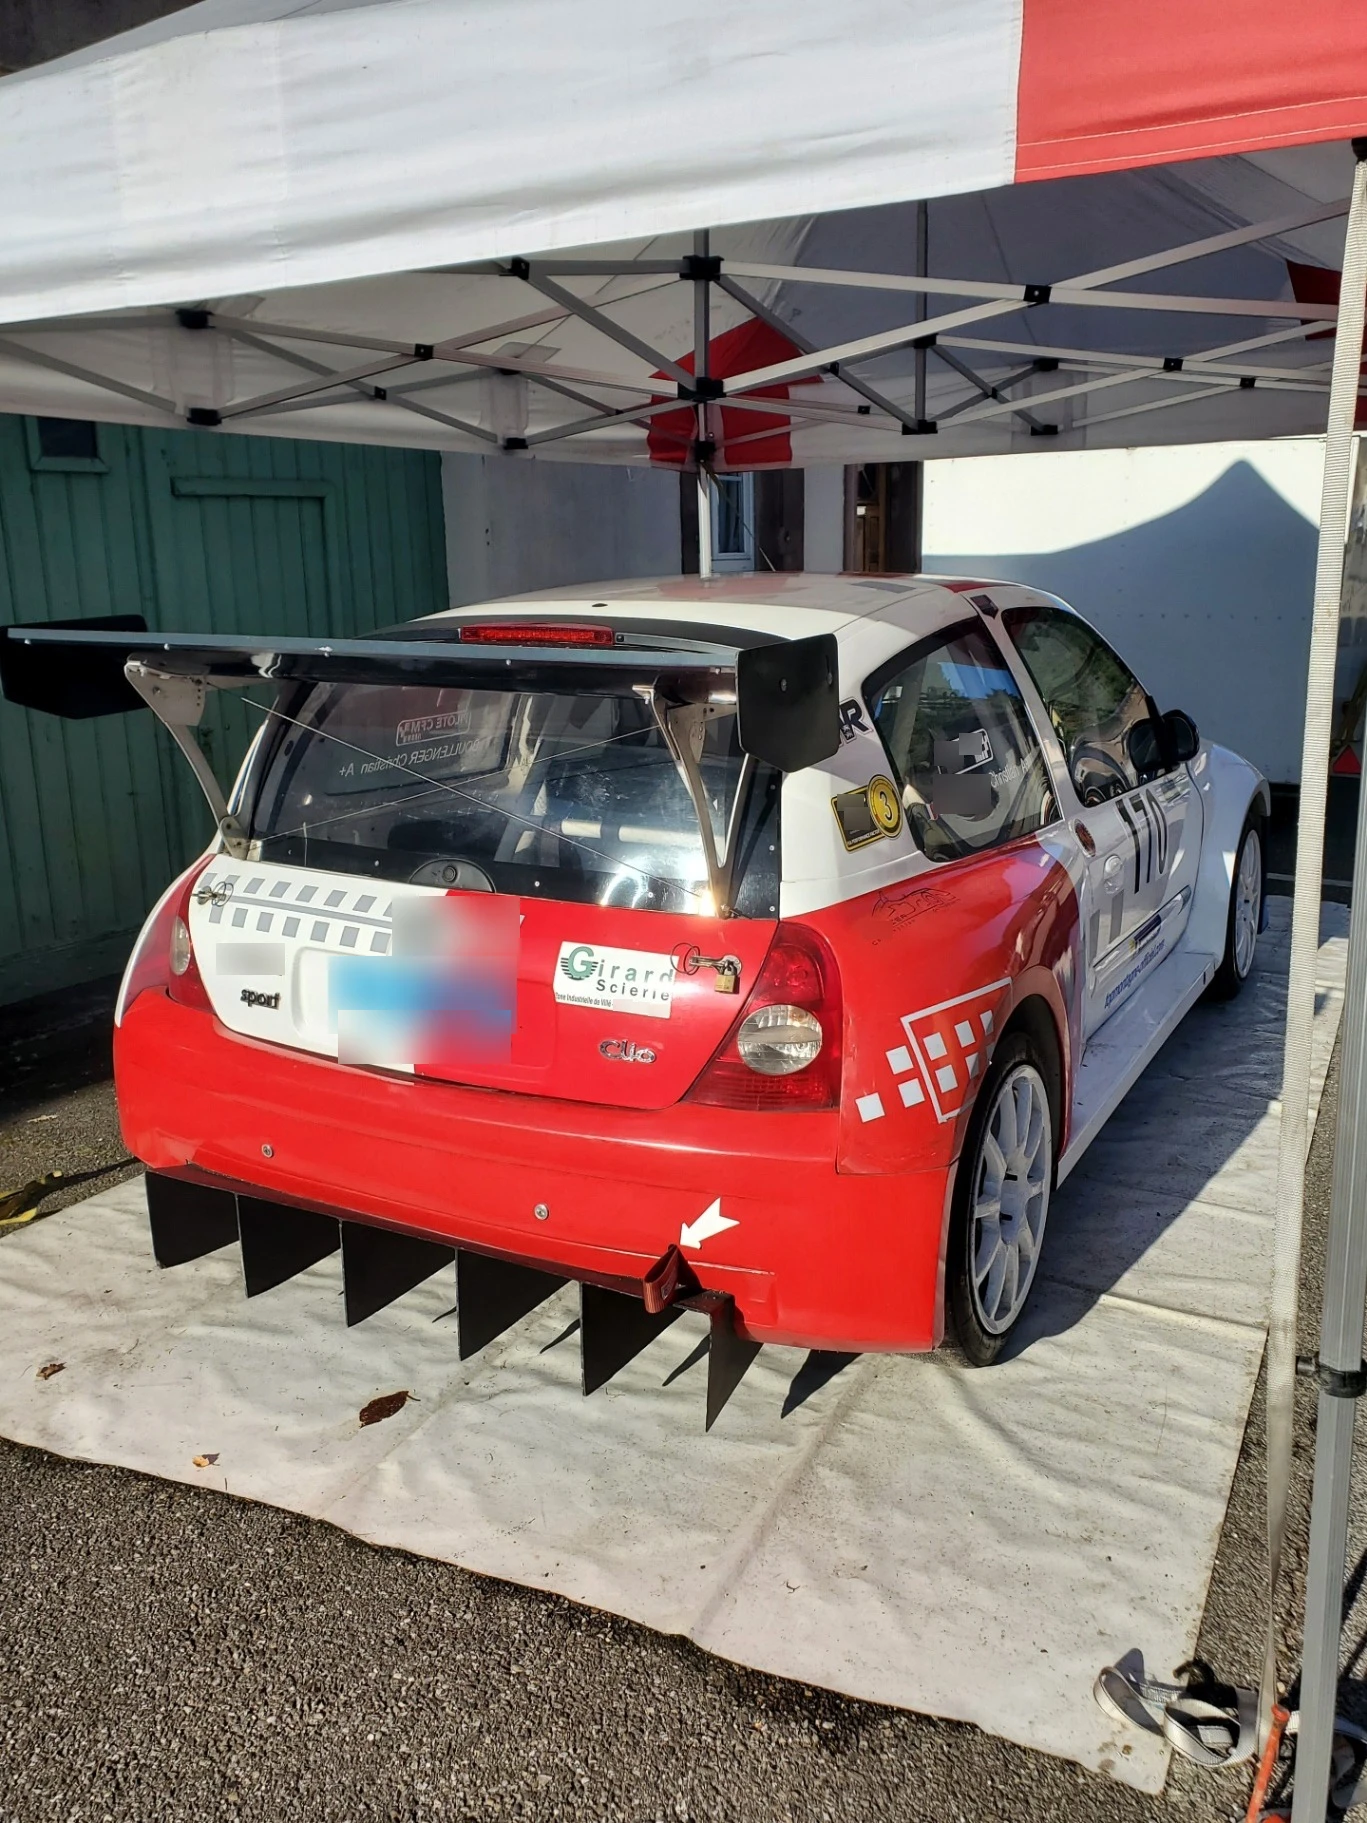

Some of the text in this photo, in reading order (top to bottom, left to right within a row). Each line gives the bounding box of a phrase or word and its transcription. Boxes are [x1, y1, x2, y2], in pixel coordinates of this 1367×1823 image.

[880, 791, 892, 821] 3
[1115, 788, 1168, 894] 170
[566, 946, 674, 980] Girard
[240, 988, 281, 1010] sport
[566, 993, 593, 1005] Industrielle
[595, 979, 670, 1001] Scierie
[599, 1039, 657, 1064] Clio
